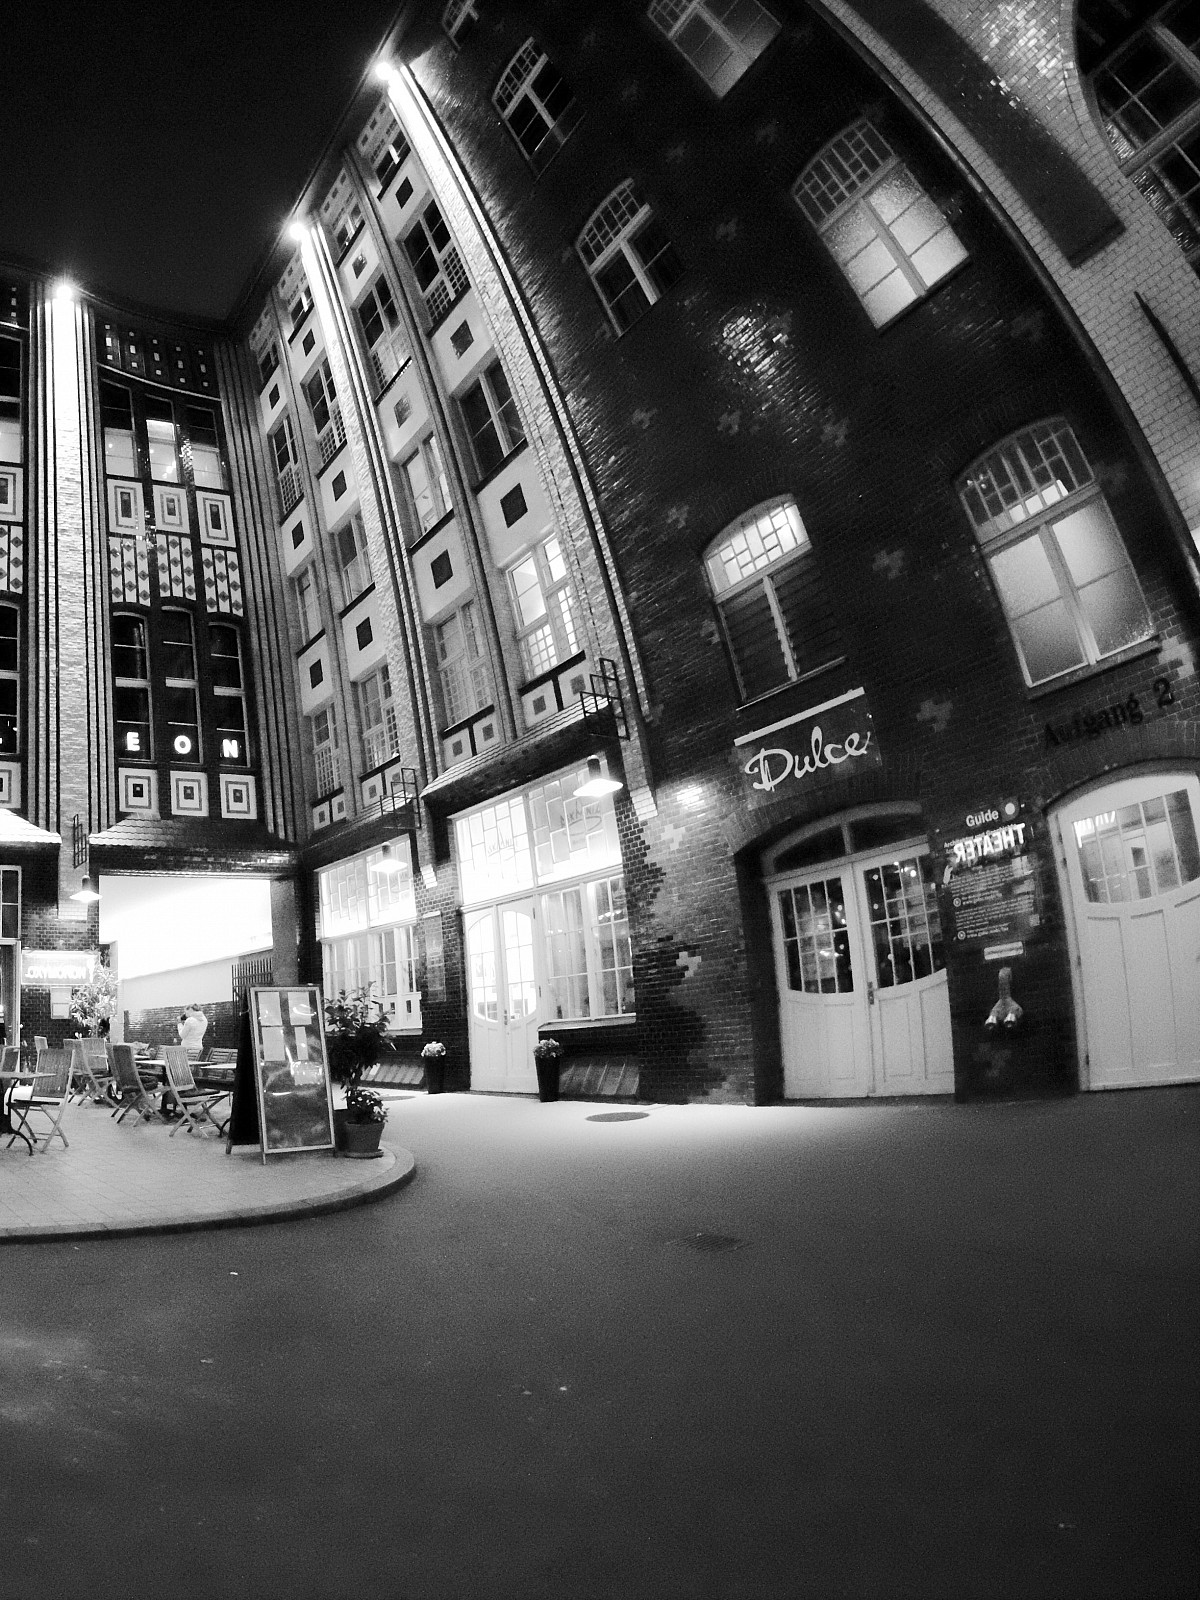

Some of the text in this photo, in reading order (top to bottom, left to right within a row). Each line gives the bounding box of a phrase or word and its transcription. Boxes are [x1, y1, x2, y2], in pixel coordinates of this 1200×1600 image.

[1045, 677, 1175, 747] Aufgang 2
[744, 726, 871, 792] Dulce
[966, 809, 999, 827] Guide
